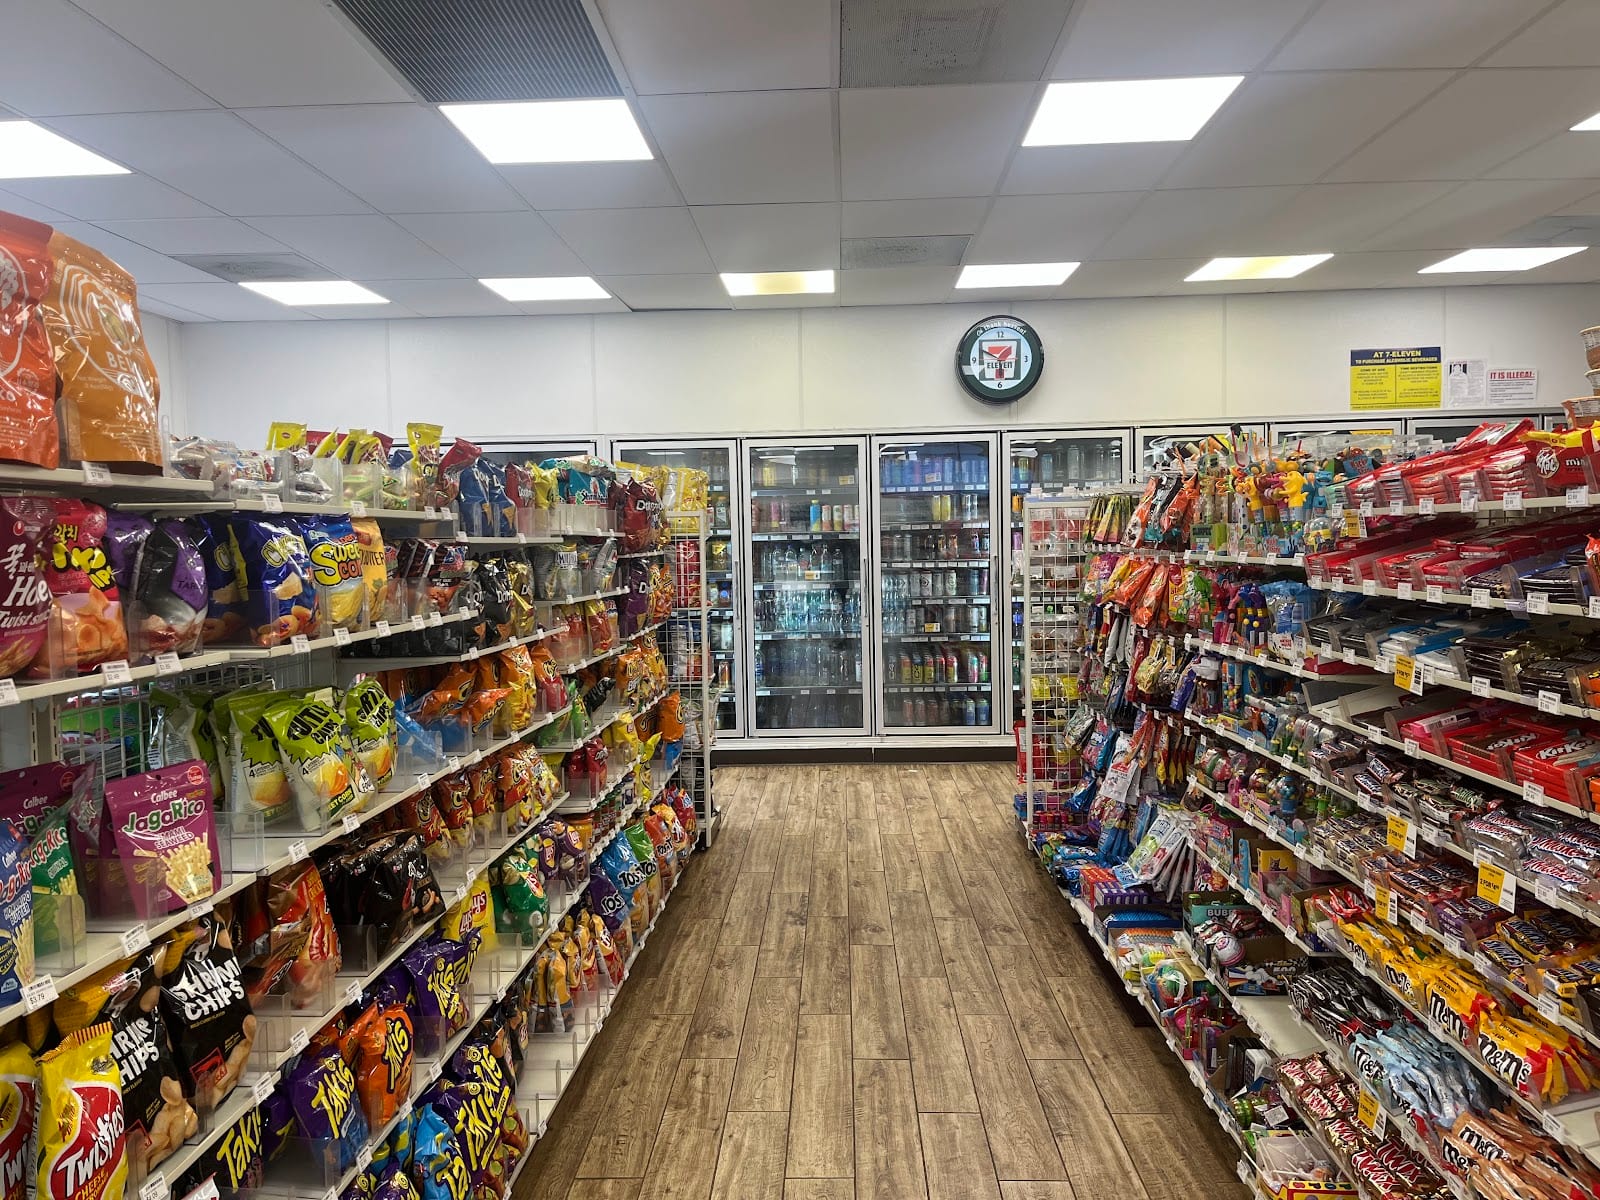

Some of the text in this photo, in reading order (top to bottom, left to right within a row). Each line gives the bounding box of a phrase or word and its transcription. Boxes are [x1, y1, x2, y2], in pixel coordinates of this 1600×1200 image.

[997, 330, 1004, 338] 12
[972, 356, 977, 364] 9
[1385, 350, 1422, 358] 7-ELEVEN
[997, 381, 1003, 389] 6
[150, 789, 178, 803] Calbee
[122, 799, 206, 833] JagaRico
[154, 831, 195, 849] SEAWEED
[184, 978, 246, 1021] CHIPS
[1477, 1032, 1532, 1087] m&m's
[310, 1056, 356, 1139] Takis
[56, 1103, 125, 1198] Twisties
